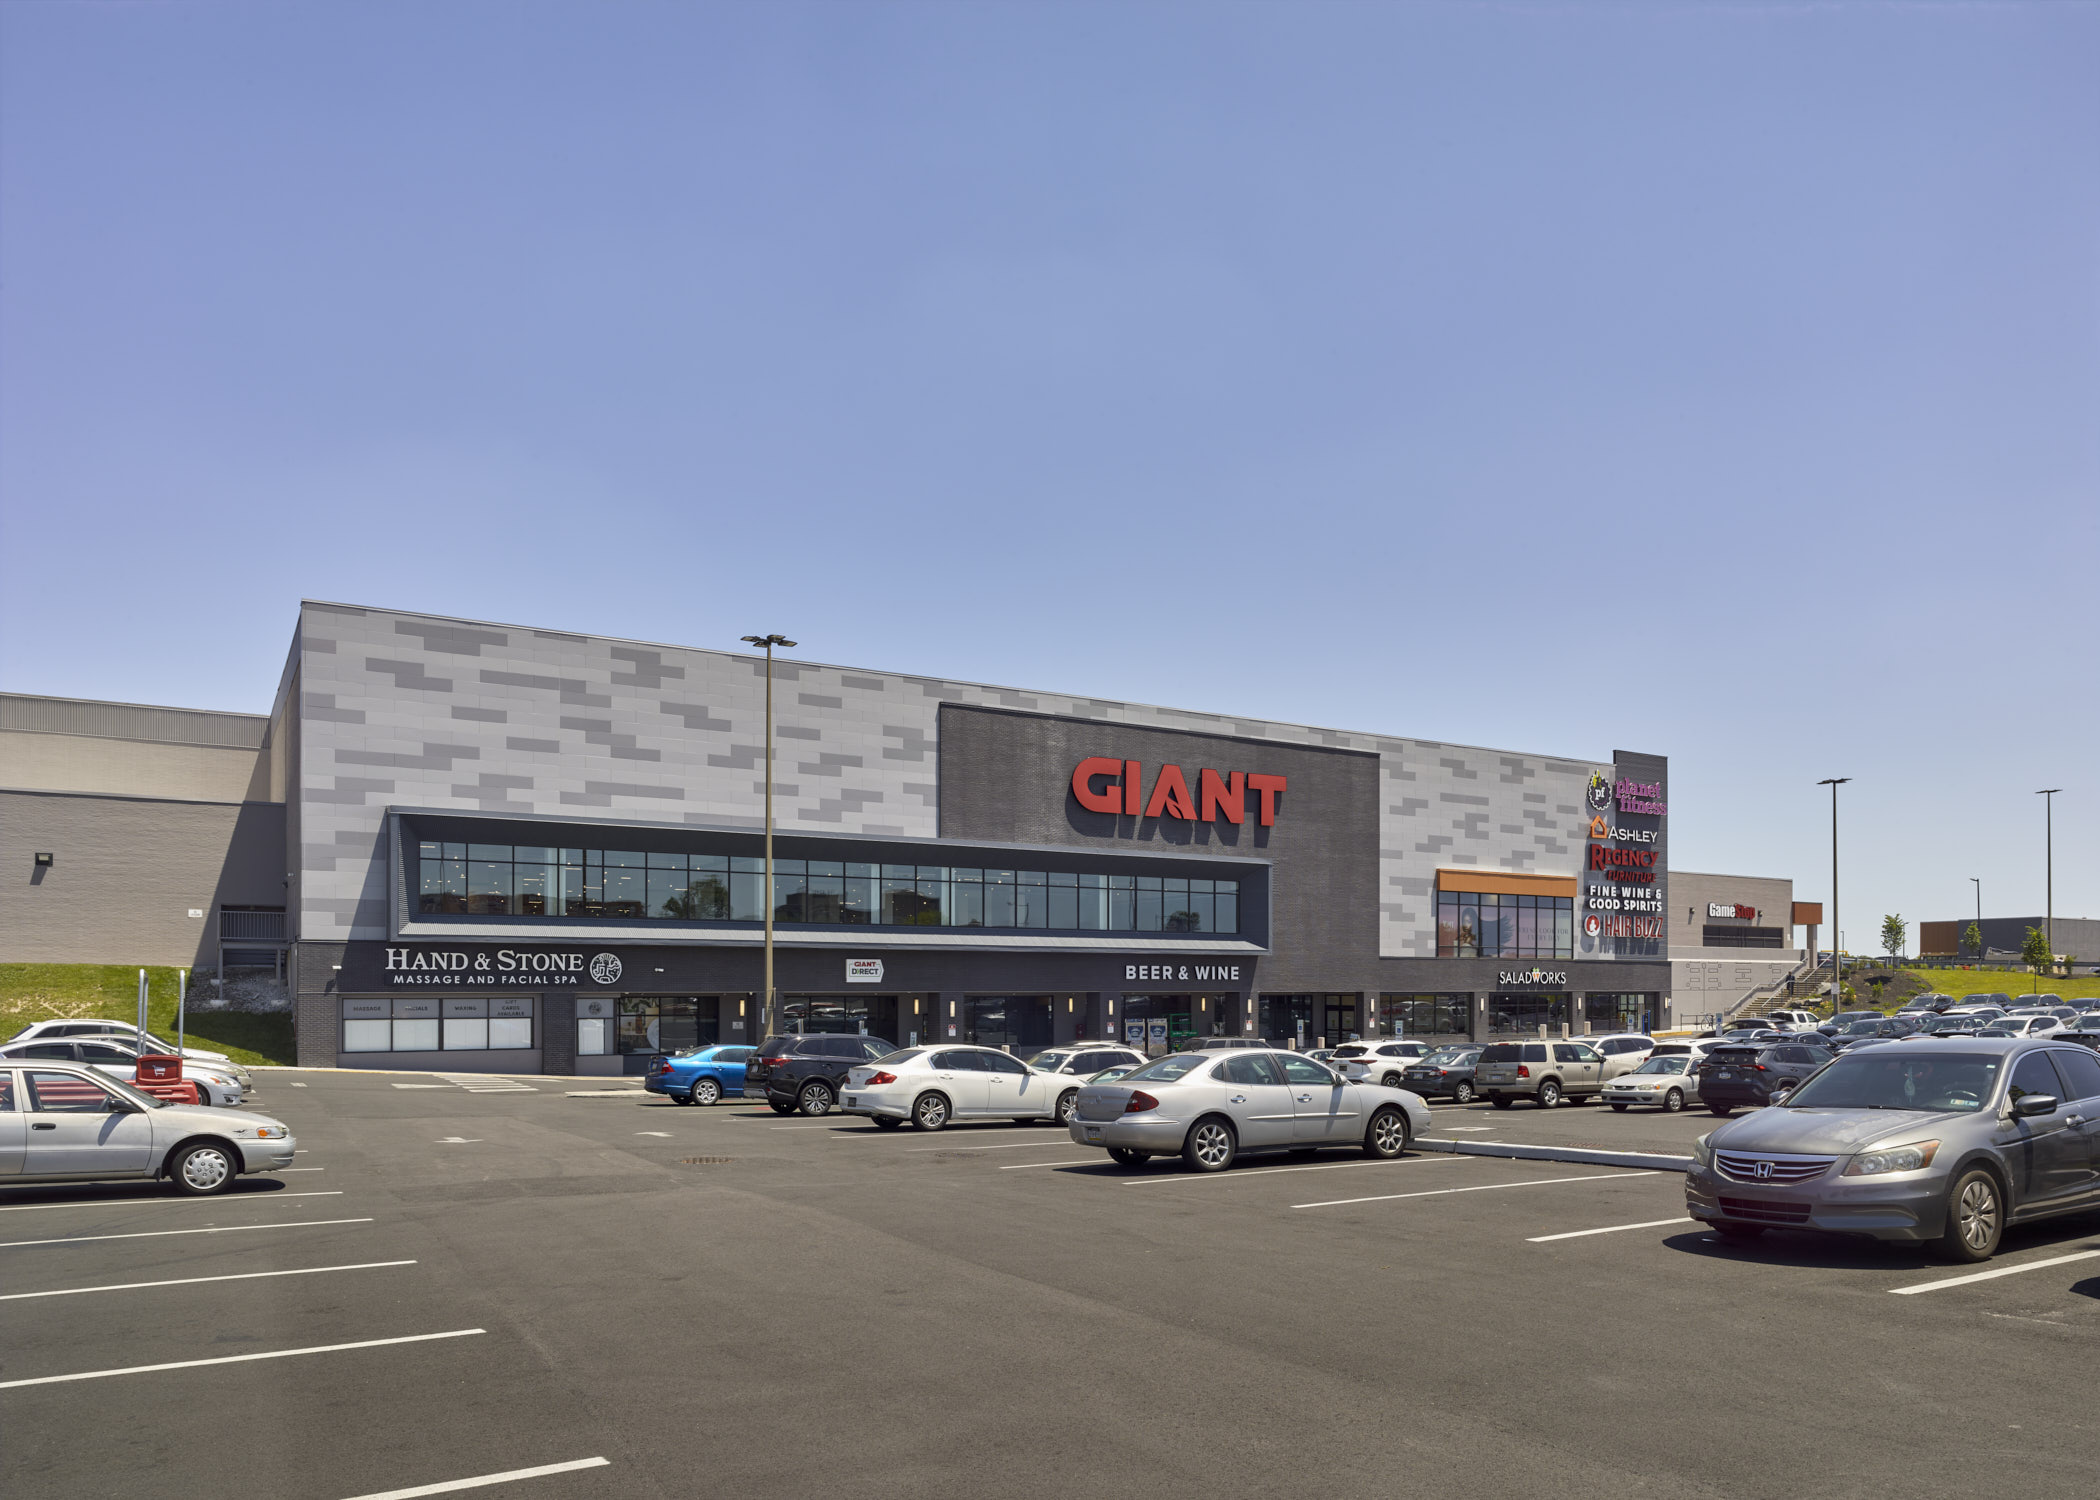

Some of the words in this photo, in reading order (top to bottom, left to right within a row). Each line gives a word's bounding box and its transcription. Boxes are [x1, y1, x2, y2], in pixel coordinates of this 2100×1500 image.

[1072, 757, 1287, 826] GIANT
[1595, 787, 1605, 800] pf
[1616, 777, 1661, 798] planet
[1620, 795, 1667, 815] fitness
[1608, 826, 1658, 843] ASHLEY
[1591, 844, 1659, 871] REGENCY
[1608, 870, 1656, 883] FURNITURE
[1590, 885, 1617, 897] FINE
[1621, 886, 1651, 898] WINE
[1655, 888, 1662, 899] &
[1589, 898, 1620, 909] GOOD
[1623, 900, 1662, 911] SPIRITS
[1709, 903, 1755, 920] GameStop
[1603, 914, 1632, 937] HAIR
[1634, 916, 1663, 938] BUZZ
[385, 949, 469, 970] HAND
[475, 953, 491, 970] &
[497, 949, 584, 971] STONE
[394, 975, 460, 984] MASSAGE
[467, 975, 495, 984] AND
[502, 975, 548, 984] FACIAL
[554, 975, 577, 984] SPA
[1126, 965, 1173, 980] BEER
[1178, 966, 1189, 980] &
[1195, 966, 1239, 980] WINE
[1500, 971, 1566, 984] SALADWORKS
